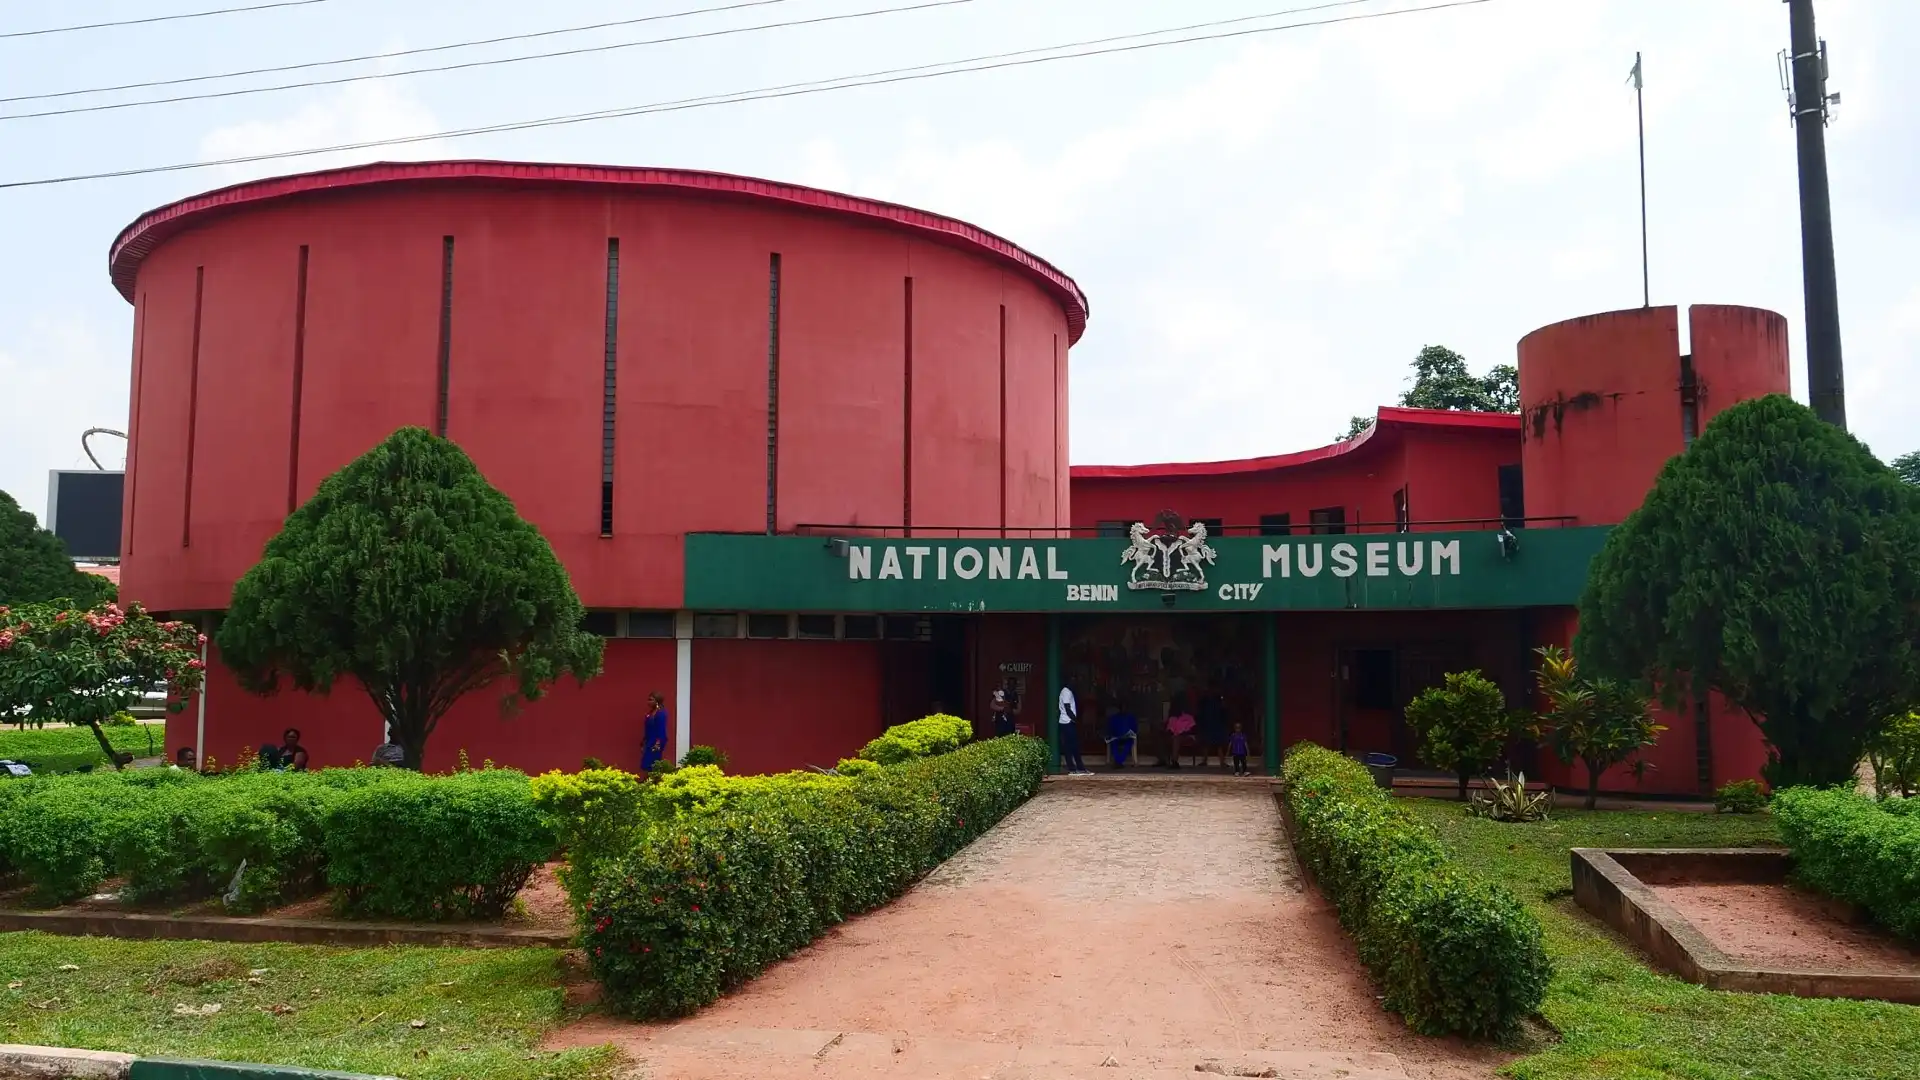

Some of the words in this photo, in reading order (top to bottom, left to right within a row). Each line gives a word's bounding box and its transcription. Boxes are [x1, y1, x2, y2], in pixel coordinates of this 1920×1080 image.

[849, 546, 1068, 580] NATIONAL
[1262, 540, 1461, 578] MUSEUM
[1066, 584, 1118, 602] BENIN
[1218, 582, 1264, 602] CITY
